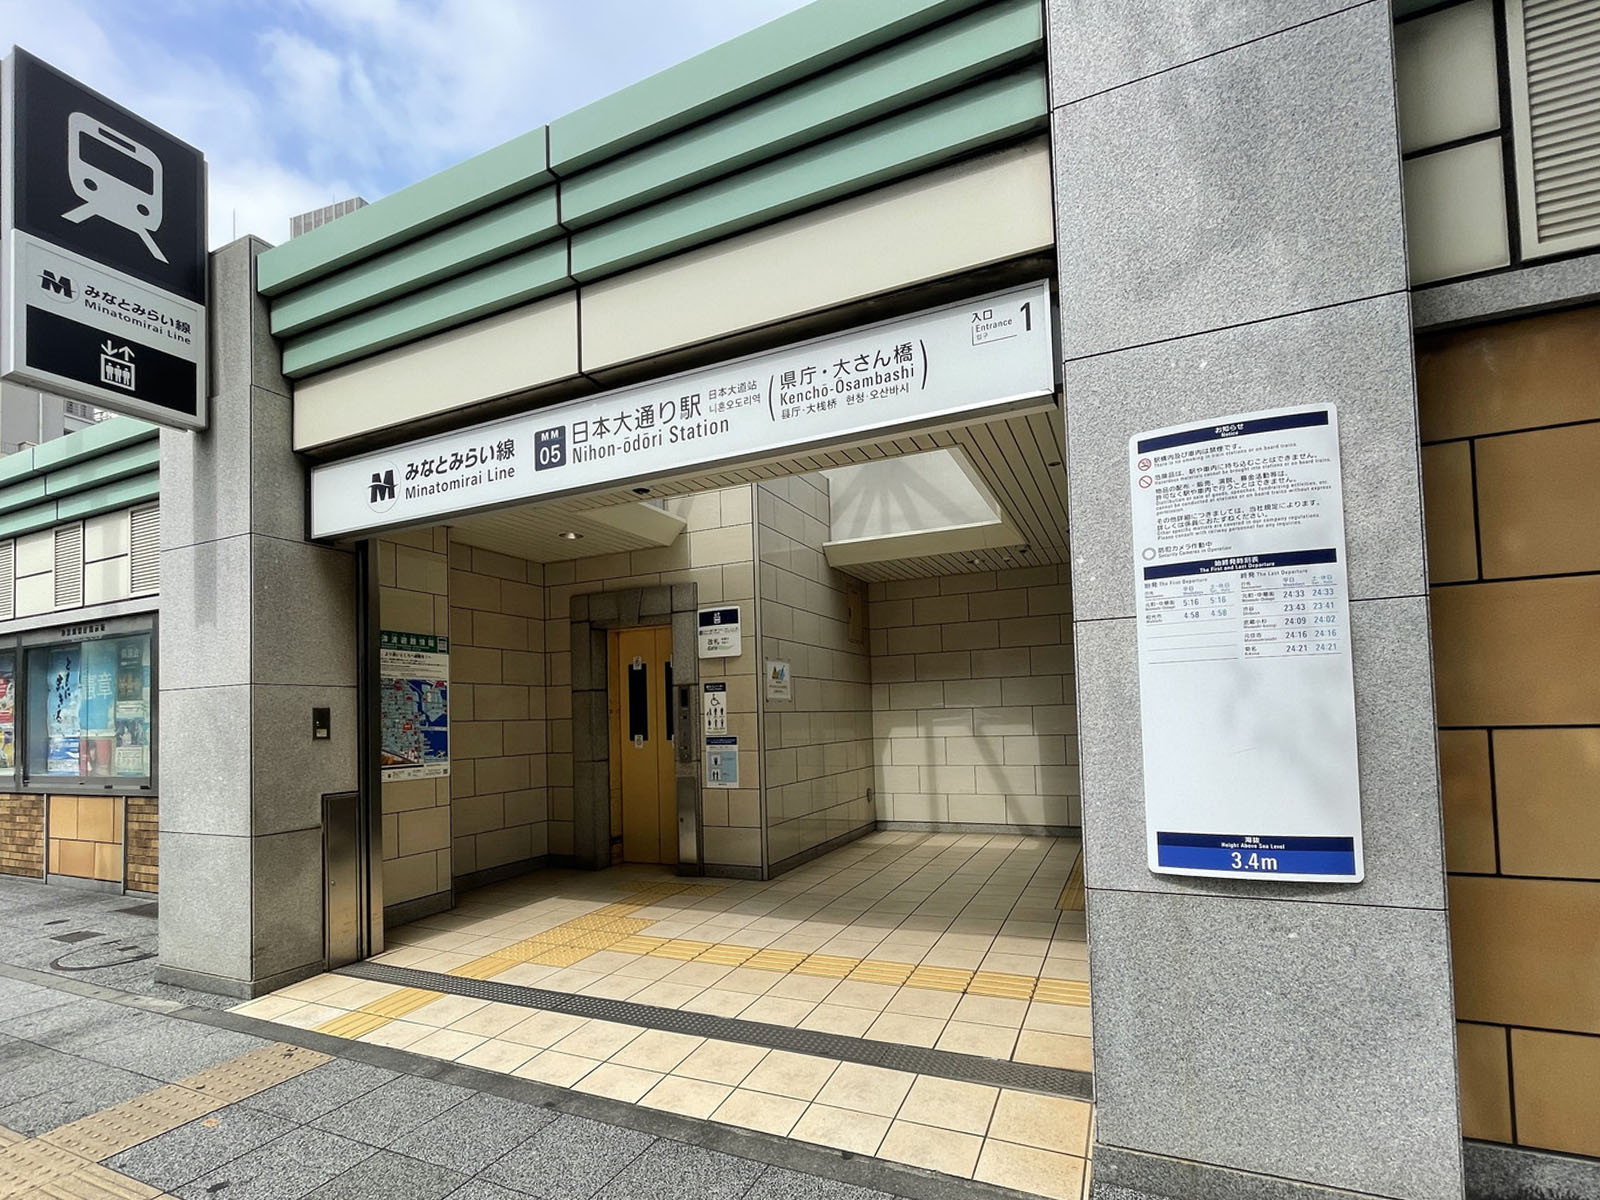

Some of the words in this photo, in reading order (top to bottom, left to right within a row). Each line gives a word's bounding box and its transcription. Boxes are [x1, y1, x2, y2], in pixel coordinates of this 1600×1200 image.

[84, 285, 192, 335] みなとみらい線
[84, 299, 164, 335] Minatomirai
[167, 330, 192, 345] Line
[971, 309, 993, 323] 入口
[975, 318, 1013, 333] Entrance
[1020, 302, 1032, 331] 1
[780, 363, 915, 406] Kenchō-Ōsambashi
[572, 393, 701, 444] 日本大通り駅
[1215, 423, 1244, 434] お知らせ
[540, 444, 561, 465] 05
[572, 429, 663, 464] Nihon-ōdōri
[669, 418, 729, 444] Station
[405, 438, 515, 481] みなとみらい線
[405, 471, 482, 500] Minatomirai
[488, 466, 515, 483] Line
[1183, 598, 1199, 606] 5:16
[1231, 851, 1278, 871] 3.4m
